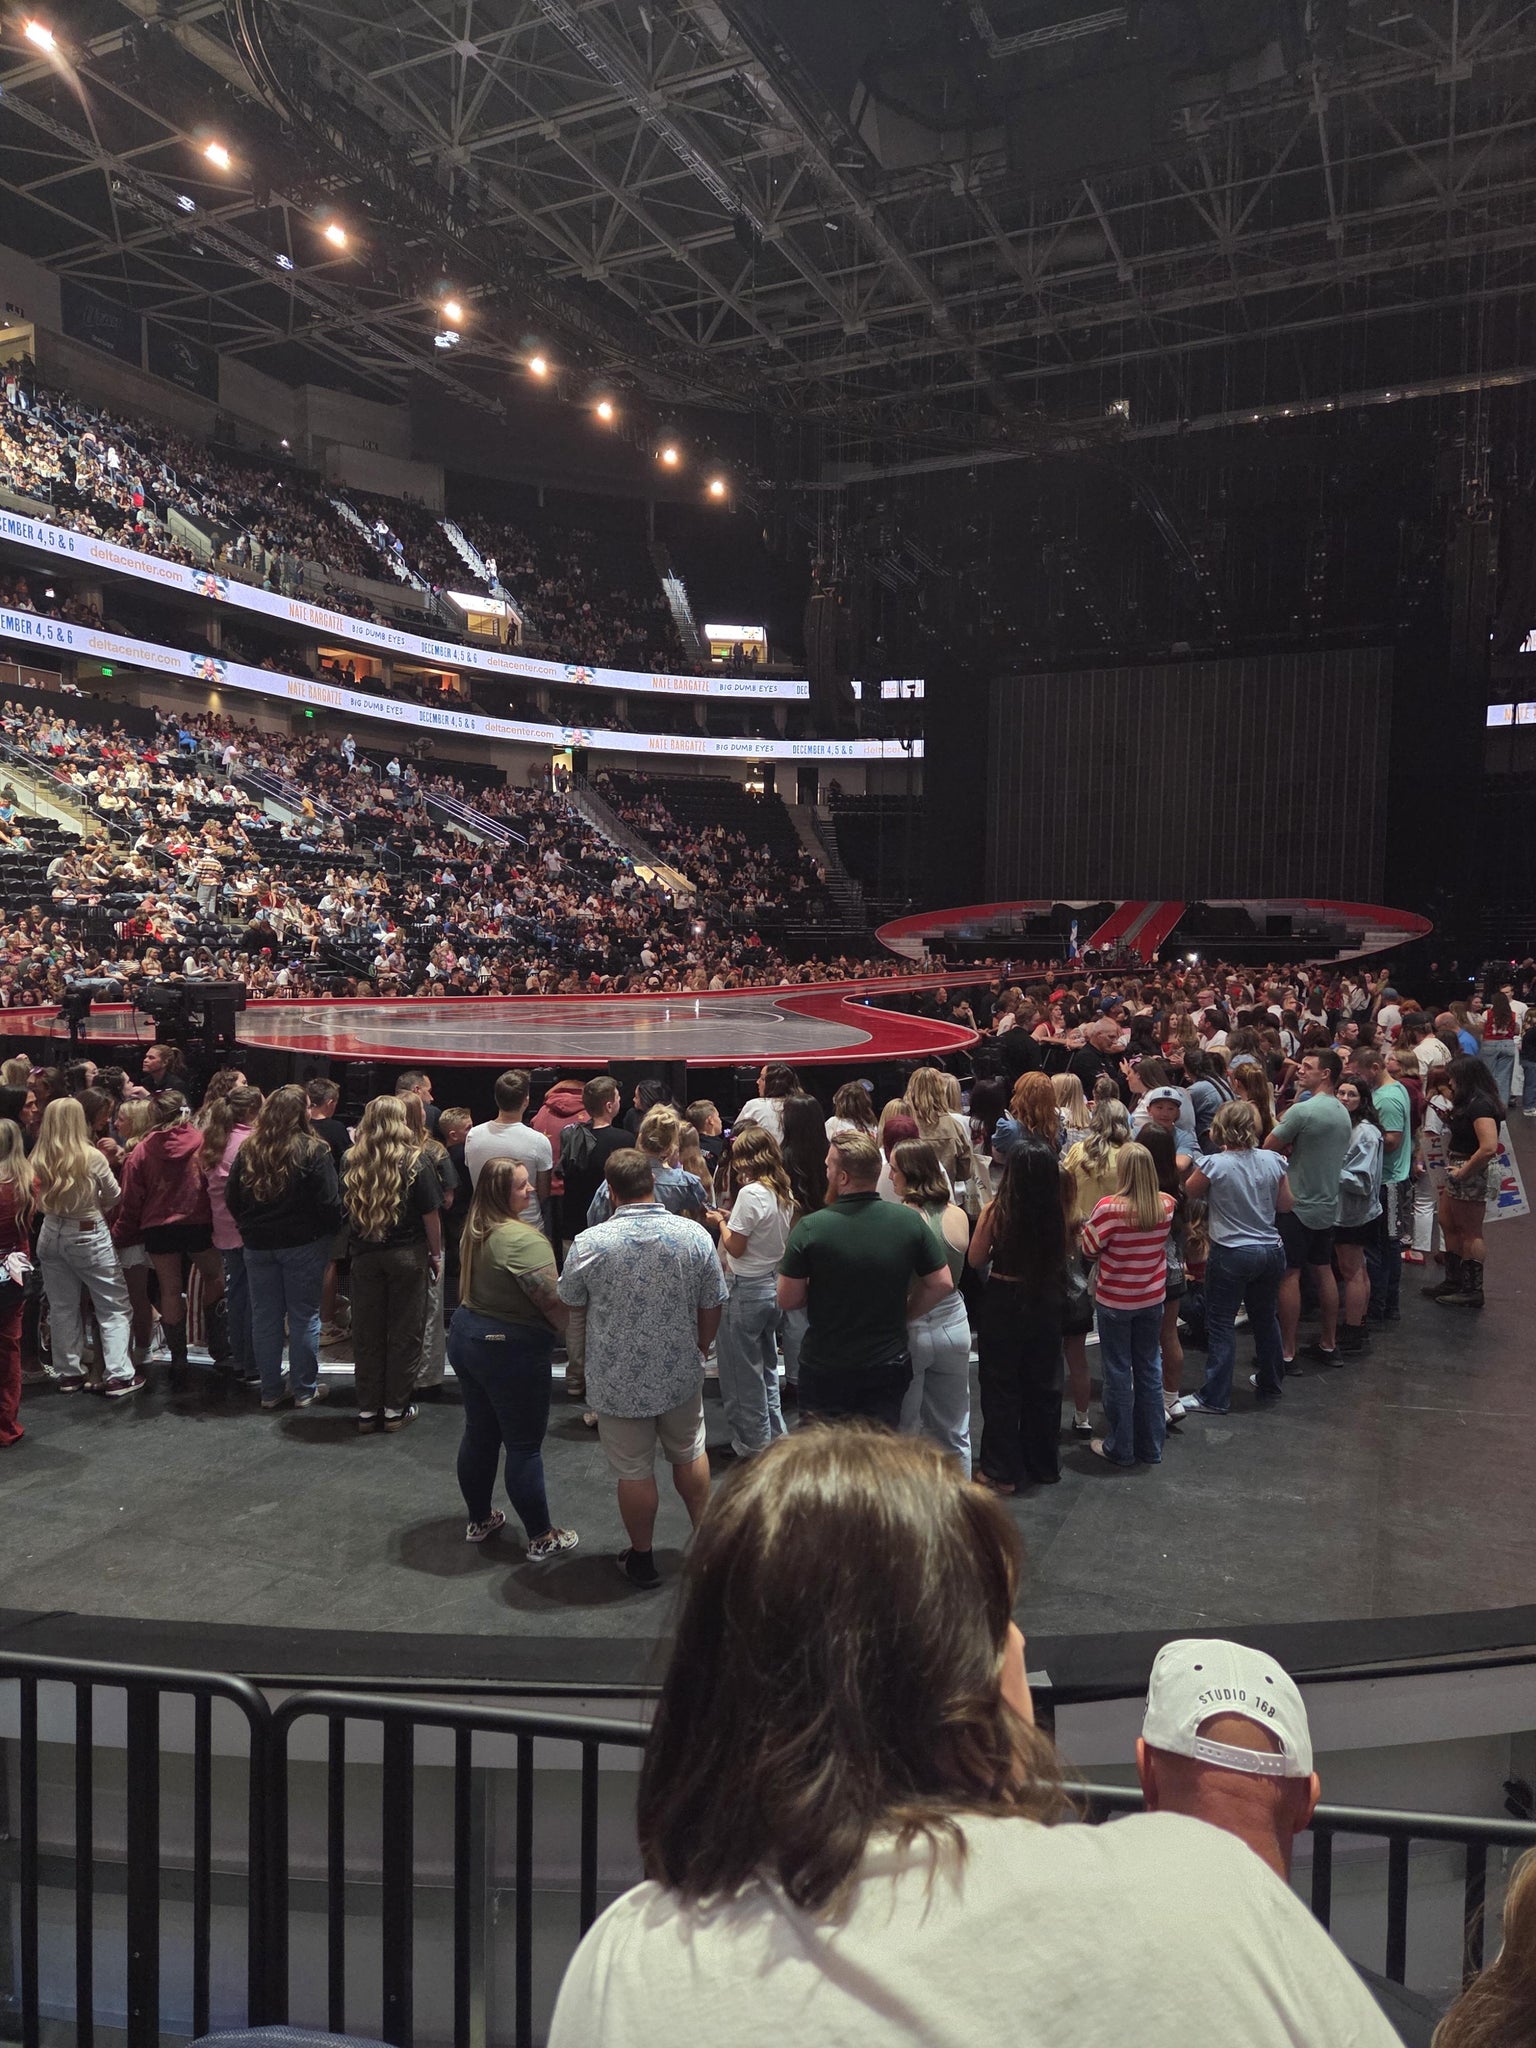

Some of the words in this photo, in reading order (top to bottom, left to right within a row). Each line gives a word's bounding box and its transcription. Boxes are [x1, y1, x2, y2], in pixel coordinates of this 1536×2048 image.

[69, 537, 74, 551] 6
[90, 545, 183, 582] deltacenter.com
[289, 603, 307, 621] NATE
[310, 611, 344, 632] BARGATZE
[68, 630, 72, 644] 6
[352, 624, 363, 635] BIG
[366, 628, 386, 641] DUMB
[388, 634, 405, 645] EYES
[88, 636, 181, 667] deltacenter.com
[421, 642, 451, 658] DECEMBER
[487, 657, 557, 676] deltacenter.com
[652, 677, 671, 689] NATE
[674, 678, 710, 692] BARGATZE
[734, 684, 756, 692] DUMB
[759, 684, 778, 693] EYES
[288, 680, 305, 696] NATE
[308, 685, 342, 706] BARGATZE
[350, 697, 362, 707] BIG
[364, 700, 384, 712] DUMB
[386, 705, 403, 716] EYES
[419, 710, 449, 726] DECEMBER
[484, 722, 554, 738] deltacenter.com
[649, 738, 667, 750] NATE
[670, 739, 706, 752] BARGATZE
[716, 743, 728, 751] BIG
[730, 744, 752, 752] DUMB
[755, 744, 774, 752] EYES
[792, 745, 825, 755] DECEMBER
[1198, 1688, 1246, 1704] STUDIO
[1255, 1697, 1276, 1718] 168
